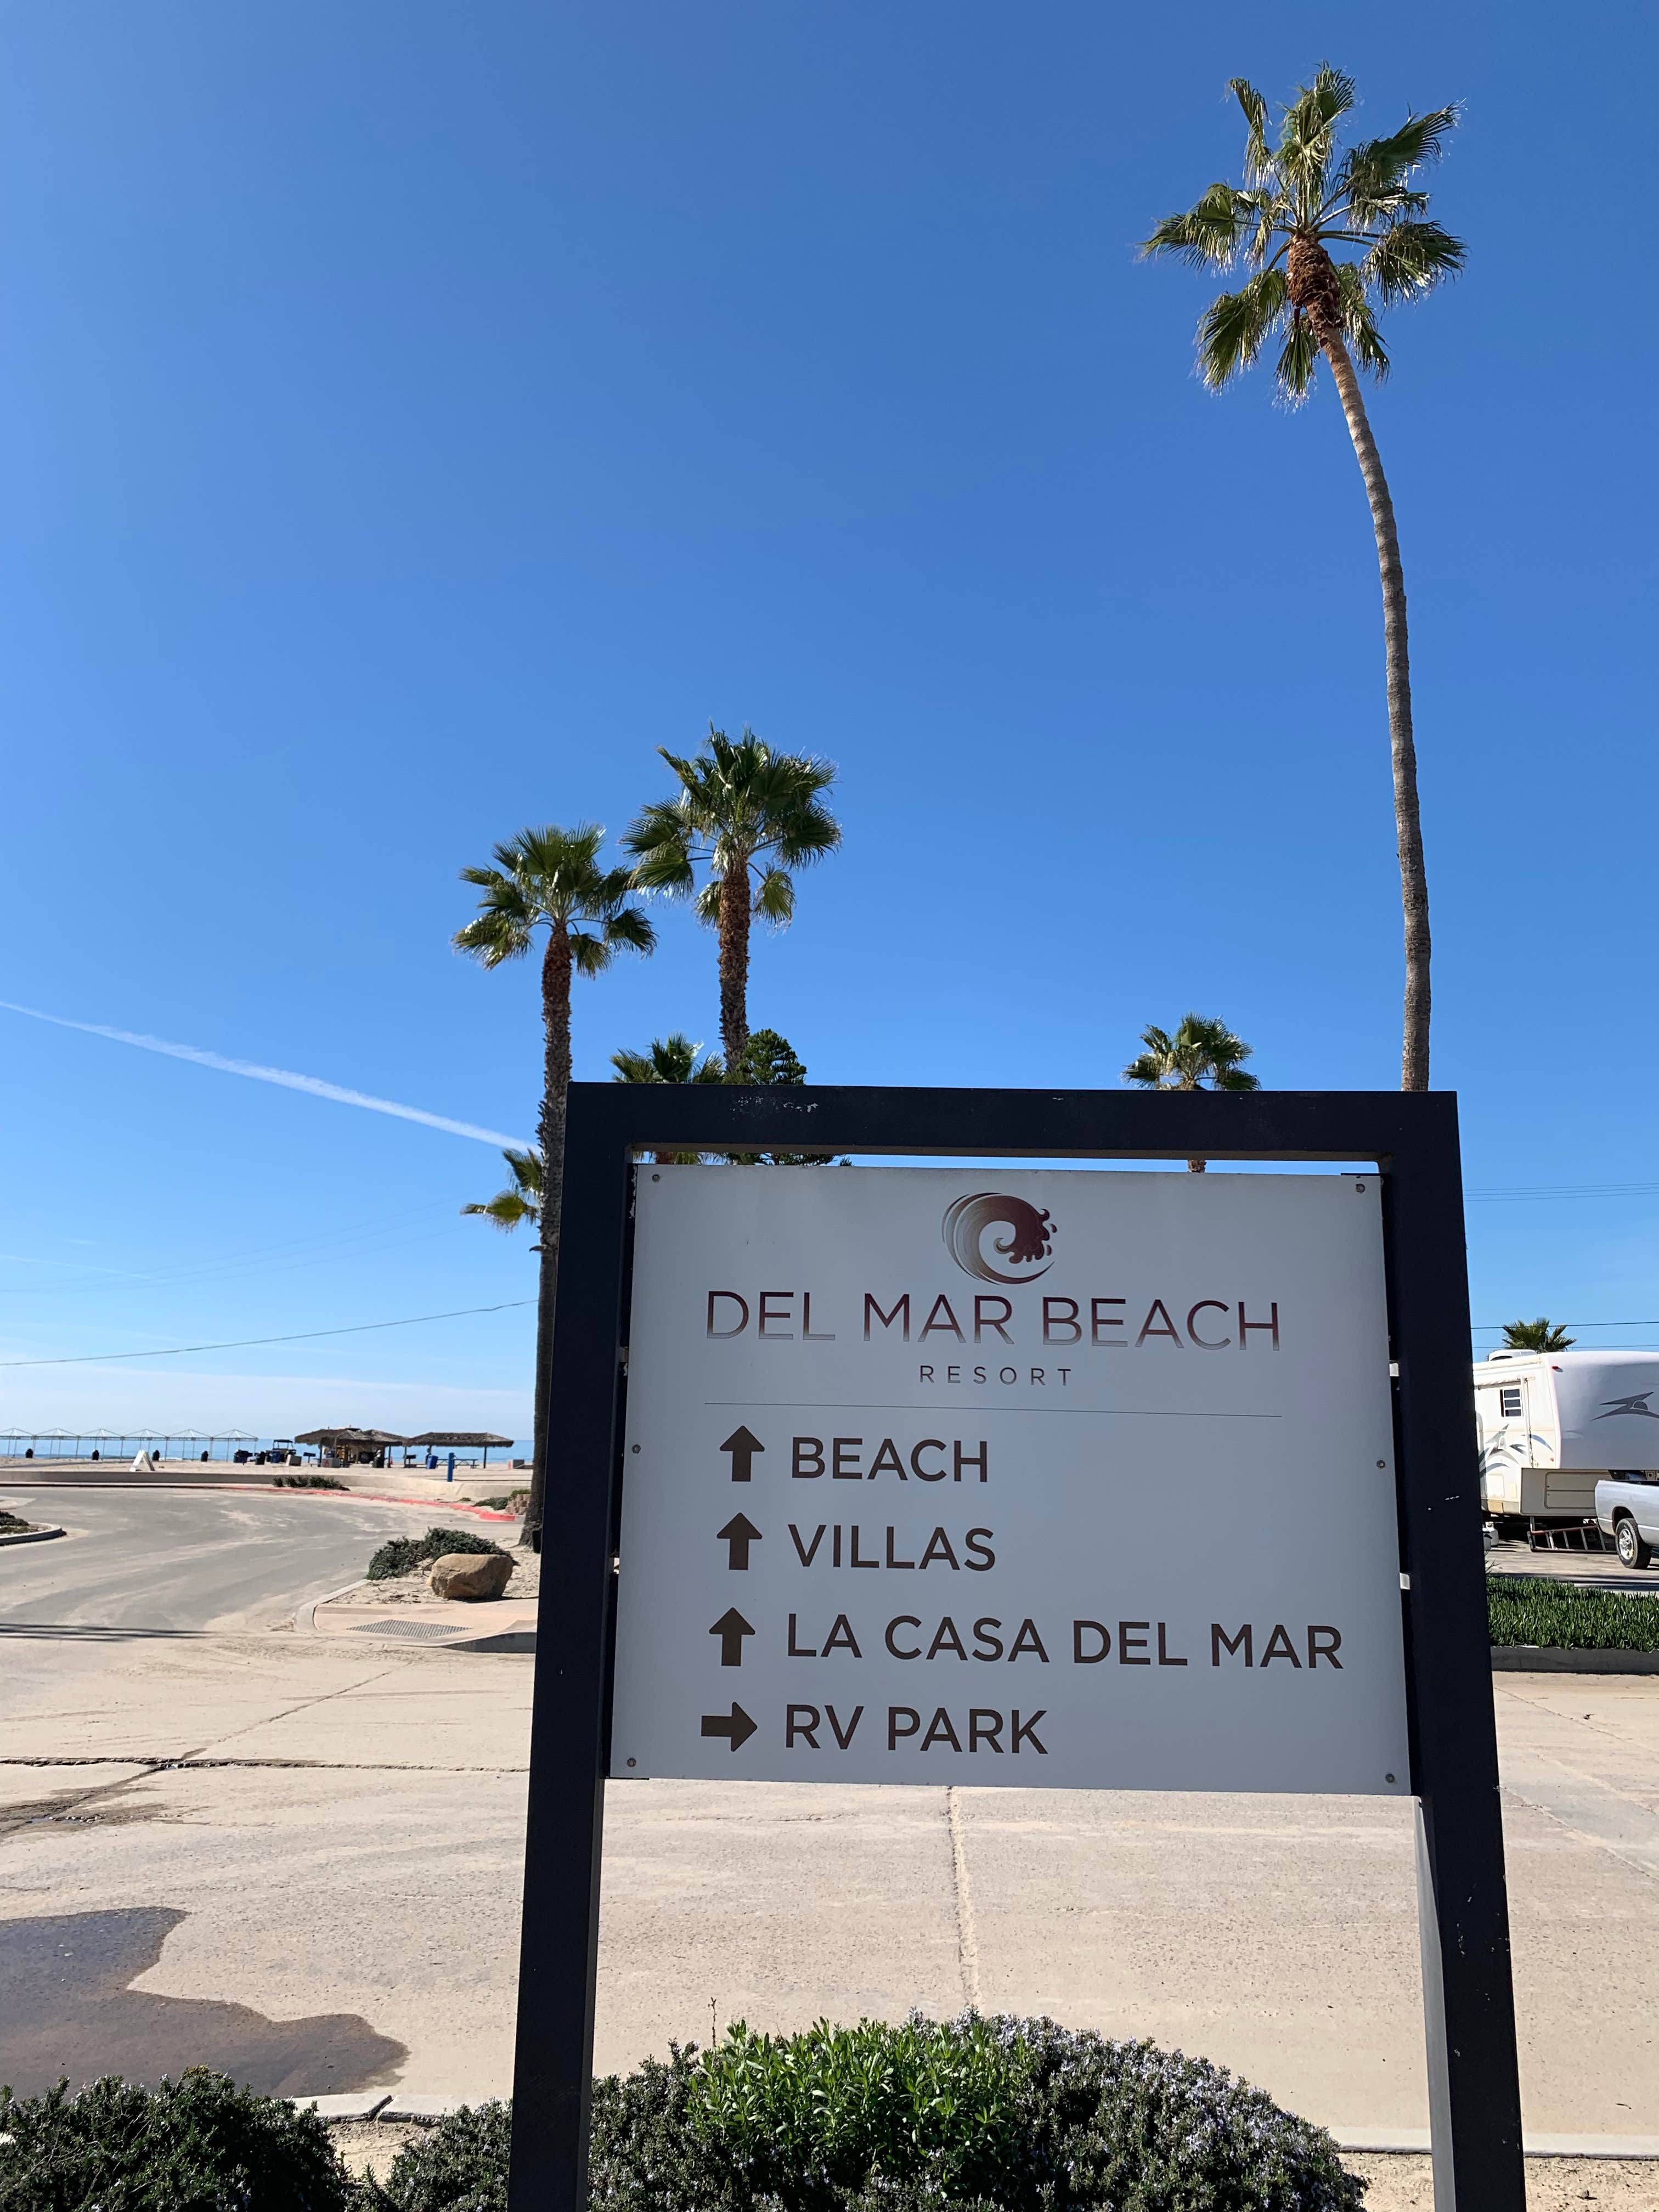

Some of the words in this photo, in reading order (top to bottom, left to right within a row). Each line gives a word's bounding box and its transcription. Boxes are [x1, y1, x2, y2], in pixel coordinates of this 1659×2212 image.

[707, 1291, 836, 1340] DEL
[864, 1293, 1014, 1344] MAR
[1042, 1297, 1279, 1351] BEACH
[920, 1365, 1071, 1386] RESORT
[792, 1437, 988, 1482] BEACH
[788, 1524, 995, 1571] VILLAS
[788, 1613, 862, 1658] LA
[885, 1615, 1049, 1663] CASA
[1073, 1620, 1188, 1666] DEL
[1211, 1623, 1344, 1669] MAR
[786, 1704, 864, 1750] RV
[888, 1707, 1048, 1754] PARK
